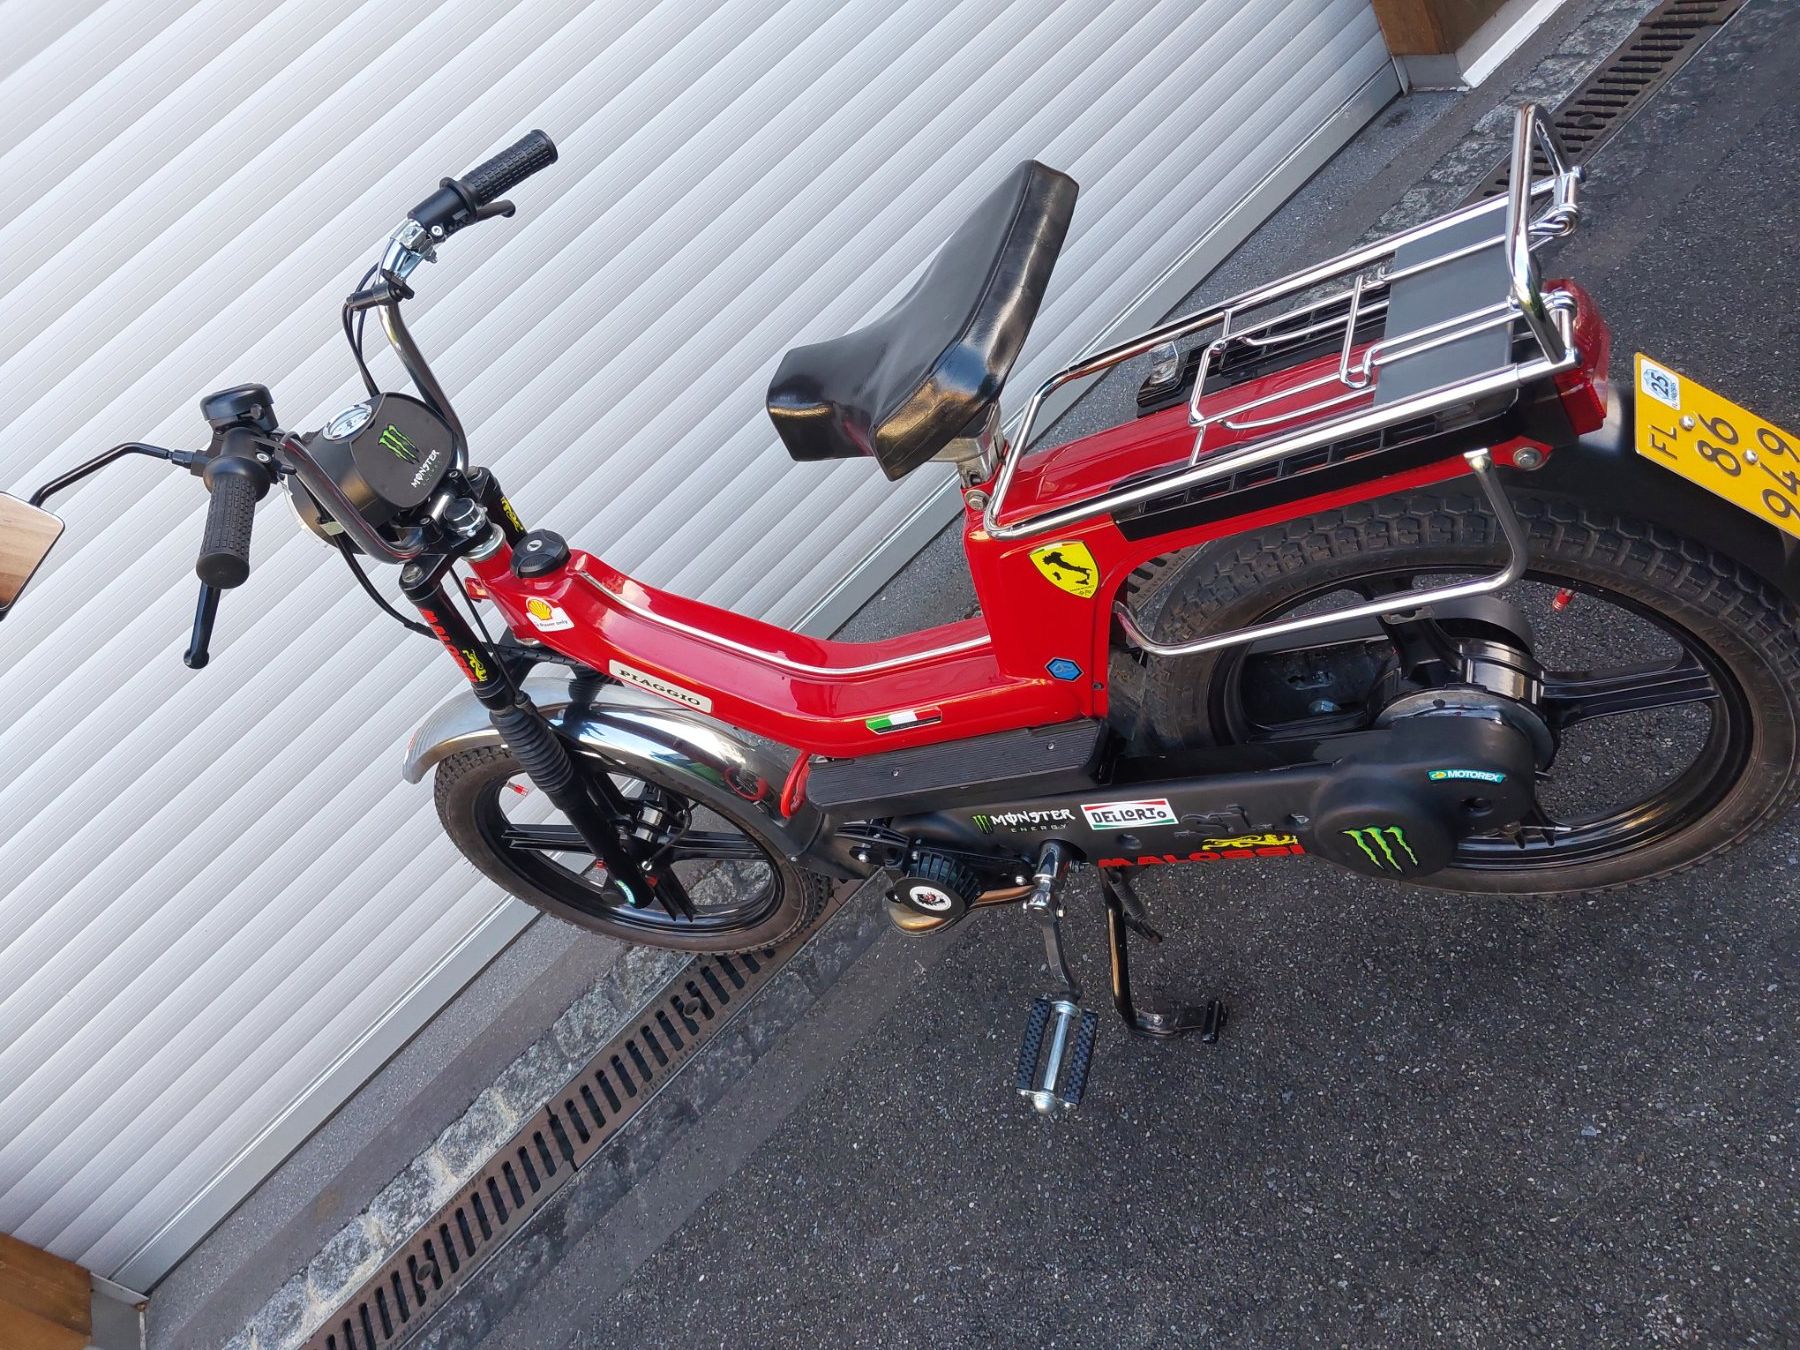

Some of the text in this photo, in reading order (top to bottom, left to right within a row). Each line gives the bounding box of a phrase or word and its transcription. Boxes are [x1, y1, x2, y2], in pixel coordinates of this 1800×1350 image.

[1650, 371, 1670, 398] 25
[1647, 424, 1679, 461] FL
[1696, 412, 1742, 478] 86
[411, 449, 440, 488] MONSTER
[1757, 427, 1800, 520] 949
[620, 669, 702, 707] PIAGGIO
[1447, 769, 1500, 782] MOTOREX
[990, 808, 1076, 827] MONSTER
[1011, 824, 1067, 834] ENERGY
[1091, 807, 1168, 824] DELLORTO
[1096, 844, 1306, 869] MALOSSI
